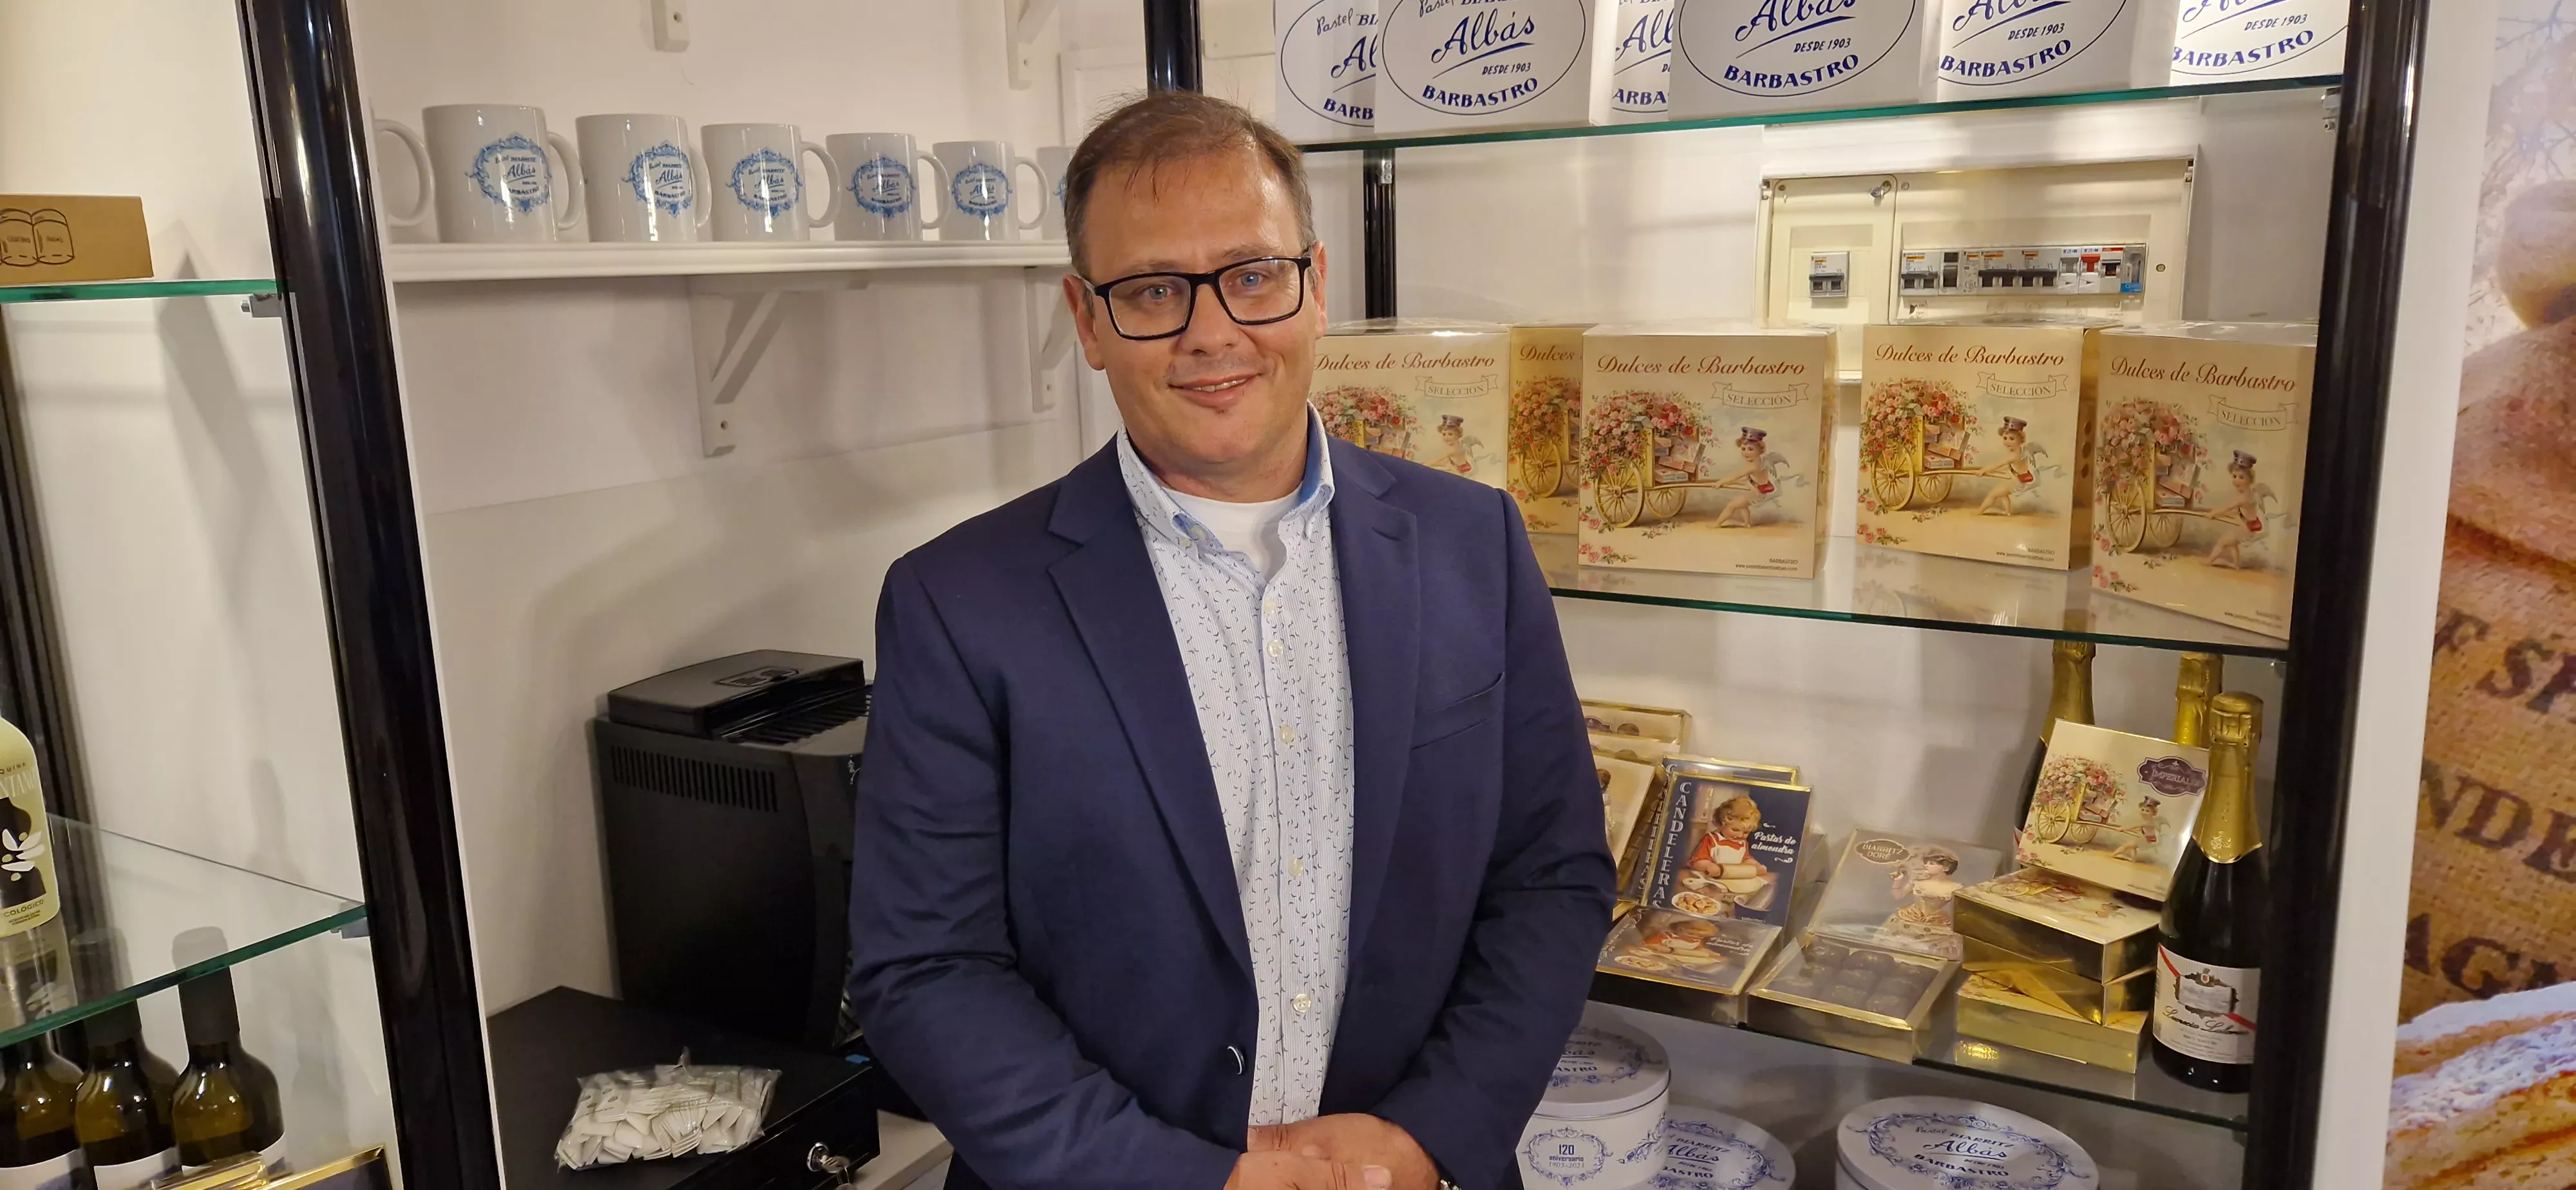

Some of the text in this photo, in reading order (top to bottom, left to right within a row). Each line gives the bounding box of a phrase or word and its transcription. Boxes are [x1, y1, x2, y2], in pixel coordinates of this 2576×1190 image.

[1316, 8, 1354, 36] Pastel
[2244, 14, 2308, 32] DESDE 1903
[1431, 8, 1535, 64] Albás
[2007, 23, 2066, 41] DESDE 1903
[1794, 37, 1852, 53] DESDE 1903
[1940, 39, 2072, 78] BARBASTRO
[1482, 62, 1531, 76] DESDE 1903
[1723, 54, 1859, 89] BARBASTRO
[1422, 77, 1538, 108] BARBASTRO
[504, 162, 536, 180] Albás
[1314, 352, 1495, 371] Dulces de Barbastro
[1520, 345, 1575, 361] Dulces
[1875, 343, 2065, 366] Dulces de Barbastro
[1596, 354, 1806, 375] Dulces de Barbastro
[2110, 356, 2296, 393] Dulces de Barbastro
[1652, 782, 1692, 909] CANDELERAS
[1754, 831, 1797, 845] Pastas de
[1751, 842, 1795, 855] almendra
[1862, 844, 1904, 855] BIARRITZ
[1559, 1144, 1575, 1155] 120
[1922, 1140, 2008, 1158] Albás
[1914, 1153, 2010, 1176] BARBASTRO
